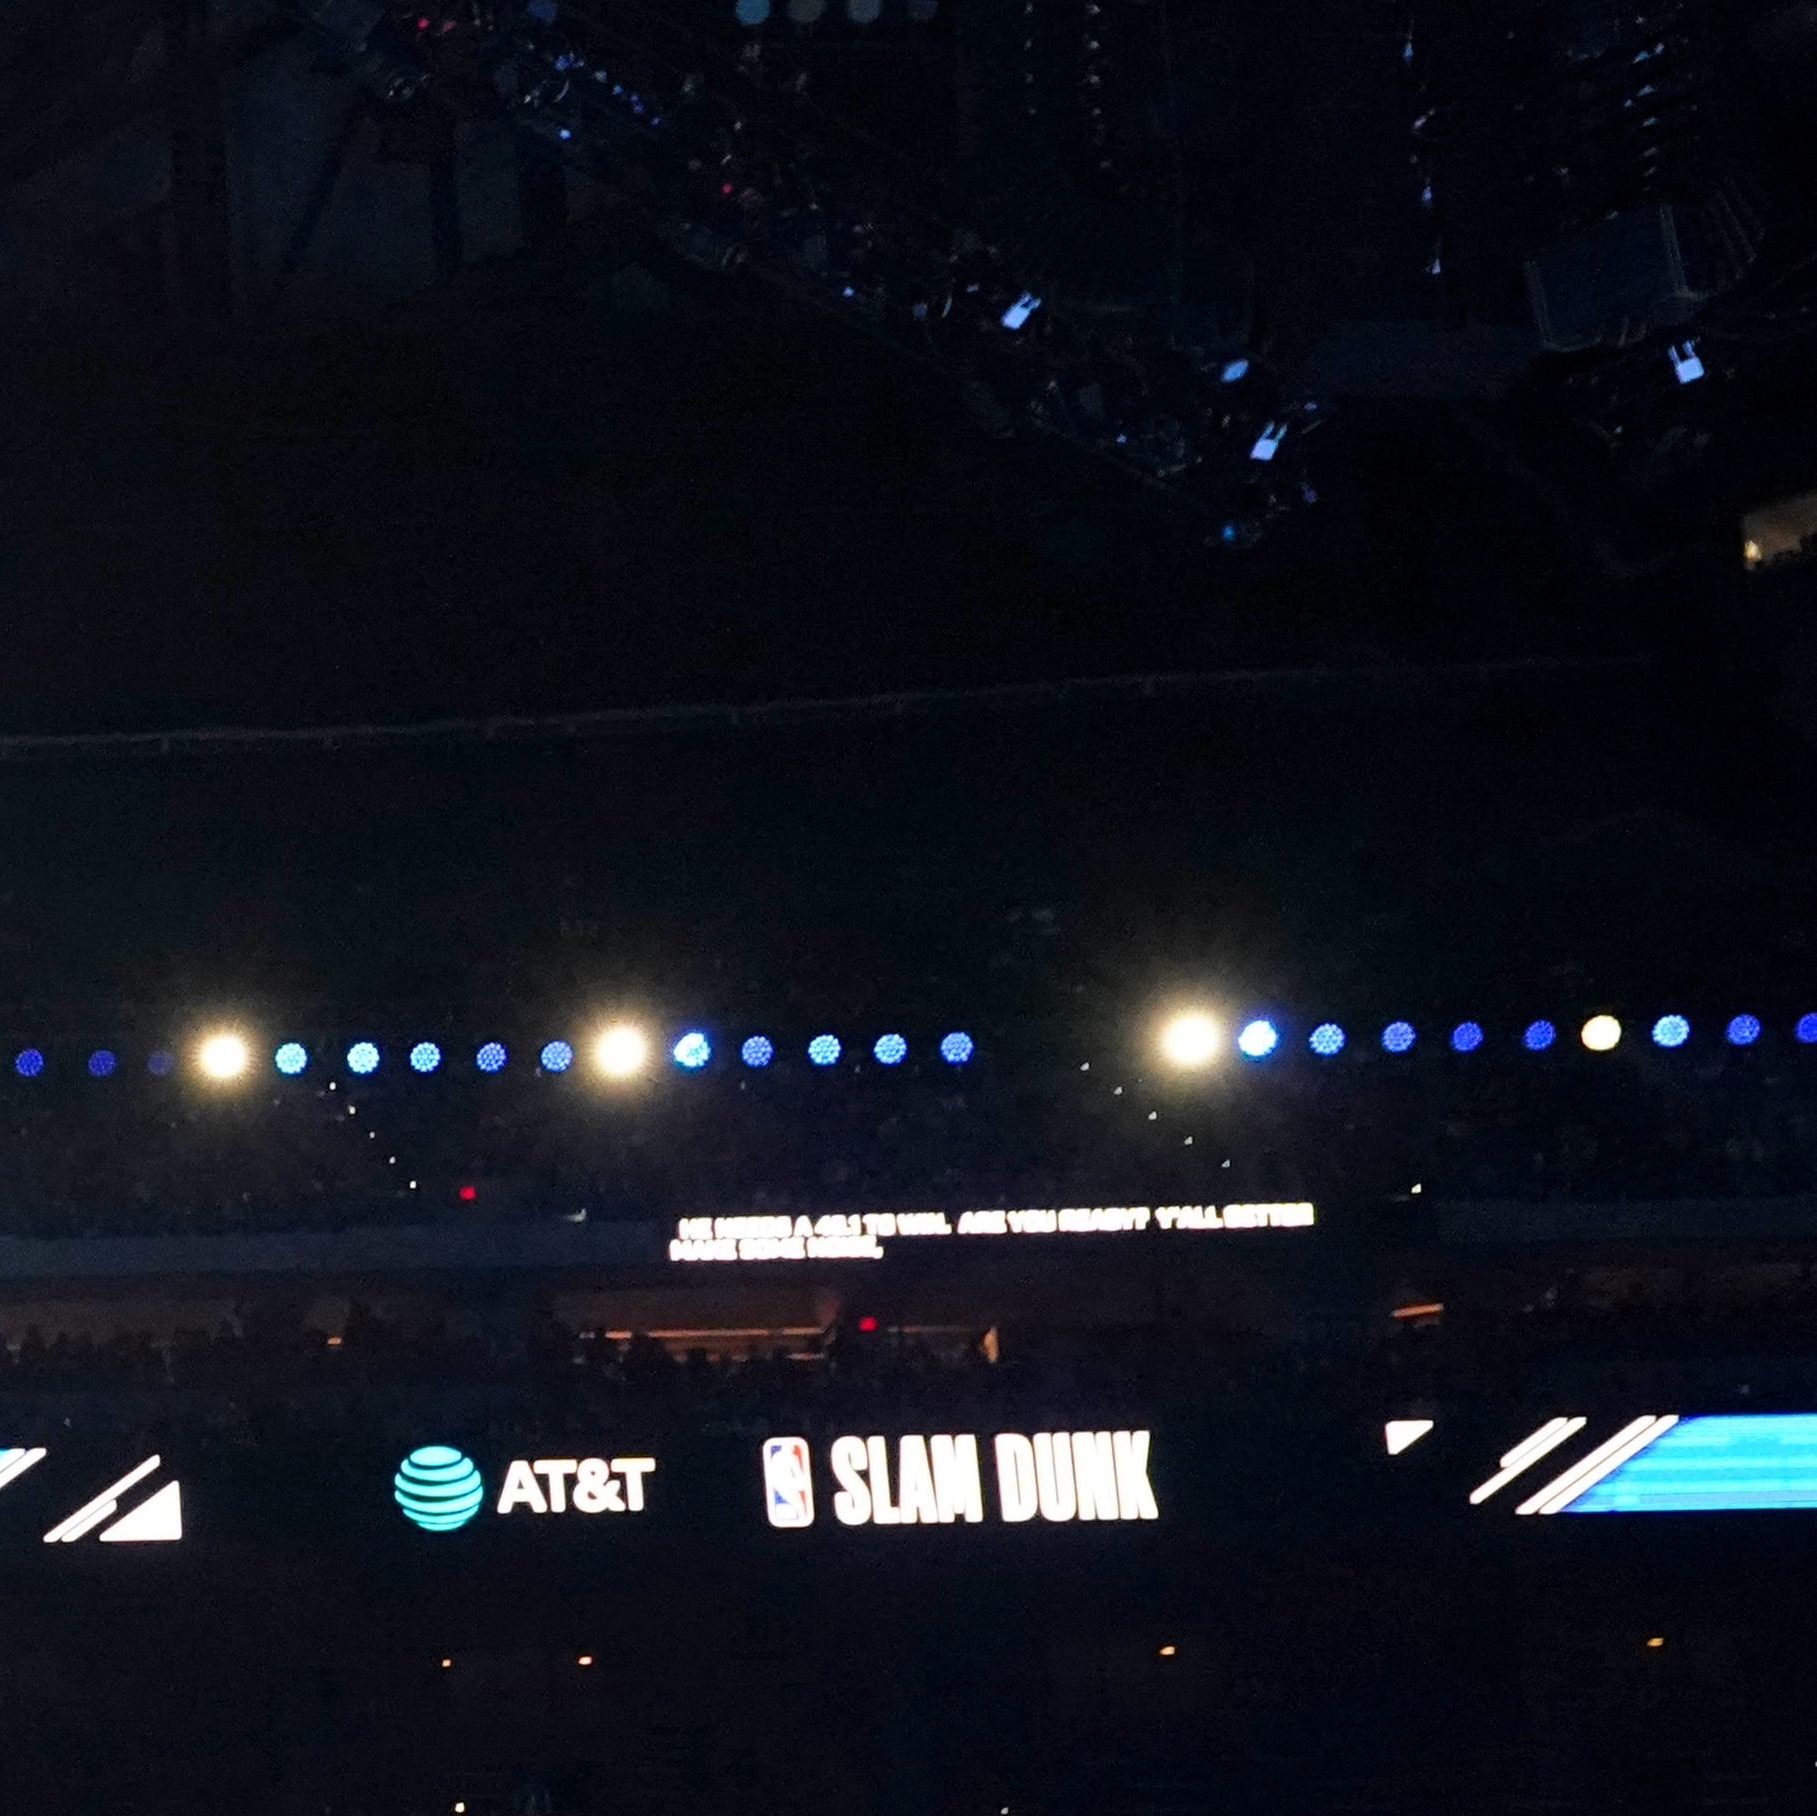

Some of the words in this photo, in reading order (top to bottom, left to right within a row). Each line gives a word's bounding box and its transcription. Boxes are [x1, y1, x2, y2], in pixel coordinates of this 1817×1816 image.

[497, 1457, 656, 1514] AT&T
[831, 1434, 984, 1526] SLAM
[994, 1430, 1159, 1523] DUNK
